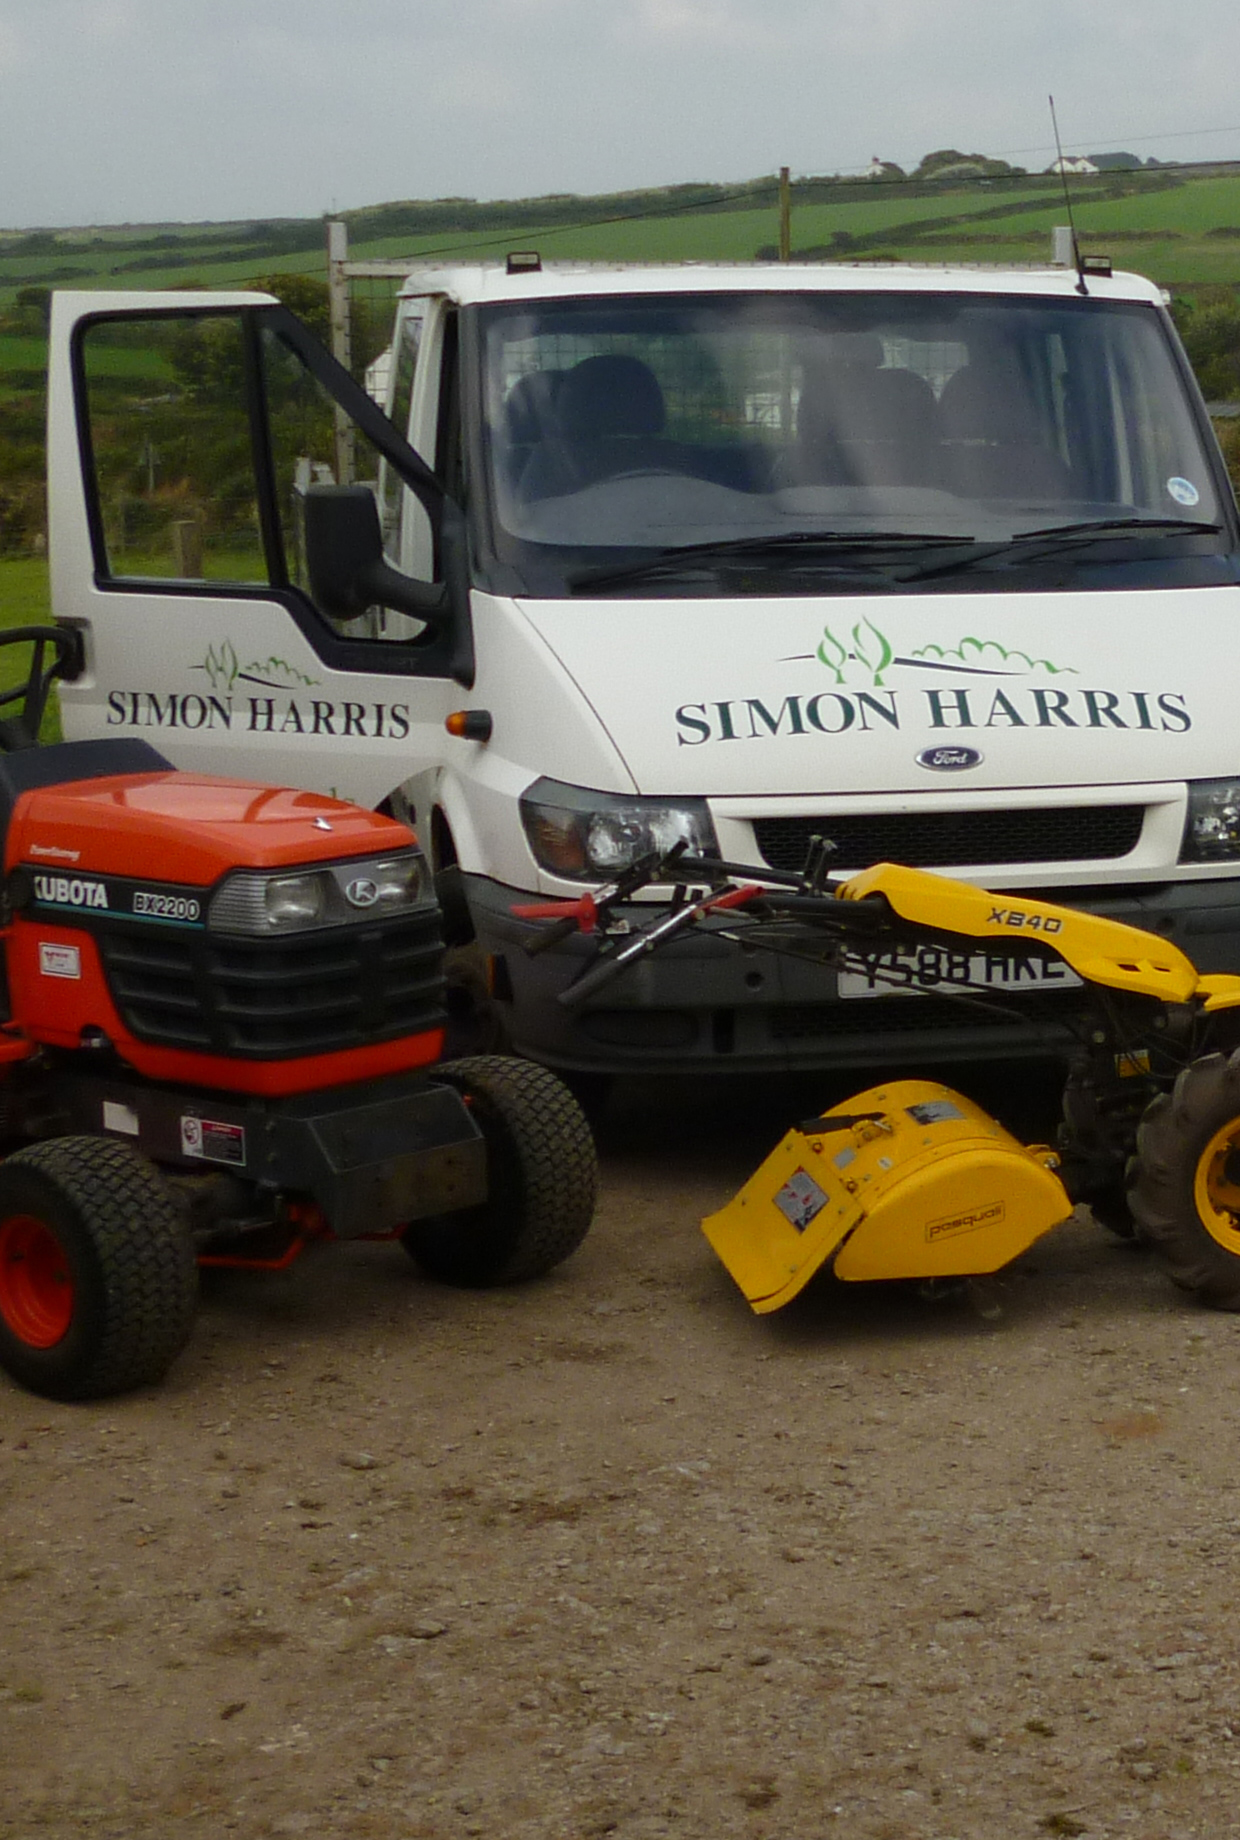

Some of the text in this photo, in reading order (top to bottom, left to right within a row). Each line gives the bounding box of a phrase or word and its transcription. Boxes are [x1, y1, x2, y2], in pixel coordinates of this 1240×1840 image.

[107, 690, 410, 739] SIMON HARRIS
[675, 688, 1192, 746] SIMON HARRIS
[933, 750, 968, 765] Ford
[133, 892, 200, 921] BX2200
[986, 907, 1063, 933] XB40
